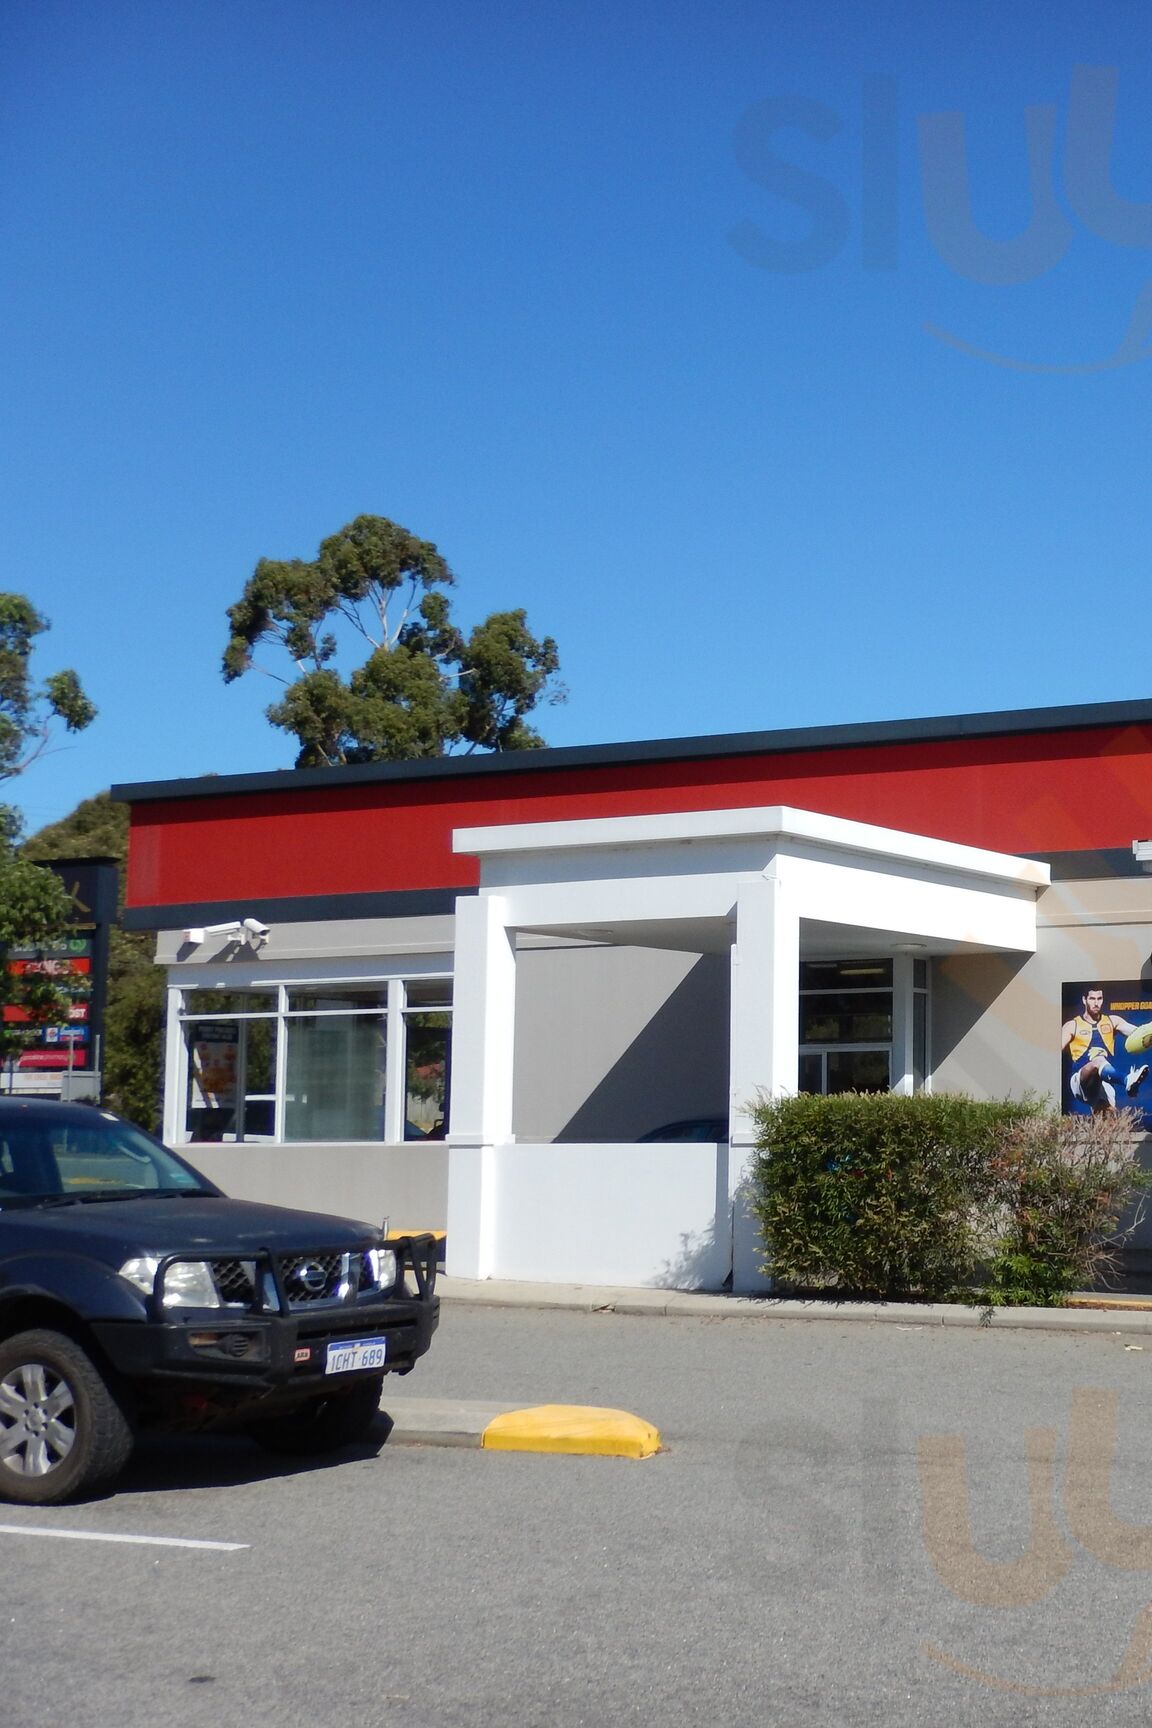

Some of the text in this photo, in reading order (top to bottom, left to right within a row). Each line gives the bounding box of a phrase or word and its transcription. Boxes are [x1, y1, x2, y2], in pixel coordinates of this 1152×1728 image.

[1110, 1001, 1139, 1010] WHOPPER
[330, 1348, 383, 1372] 1CHT 689
